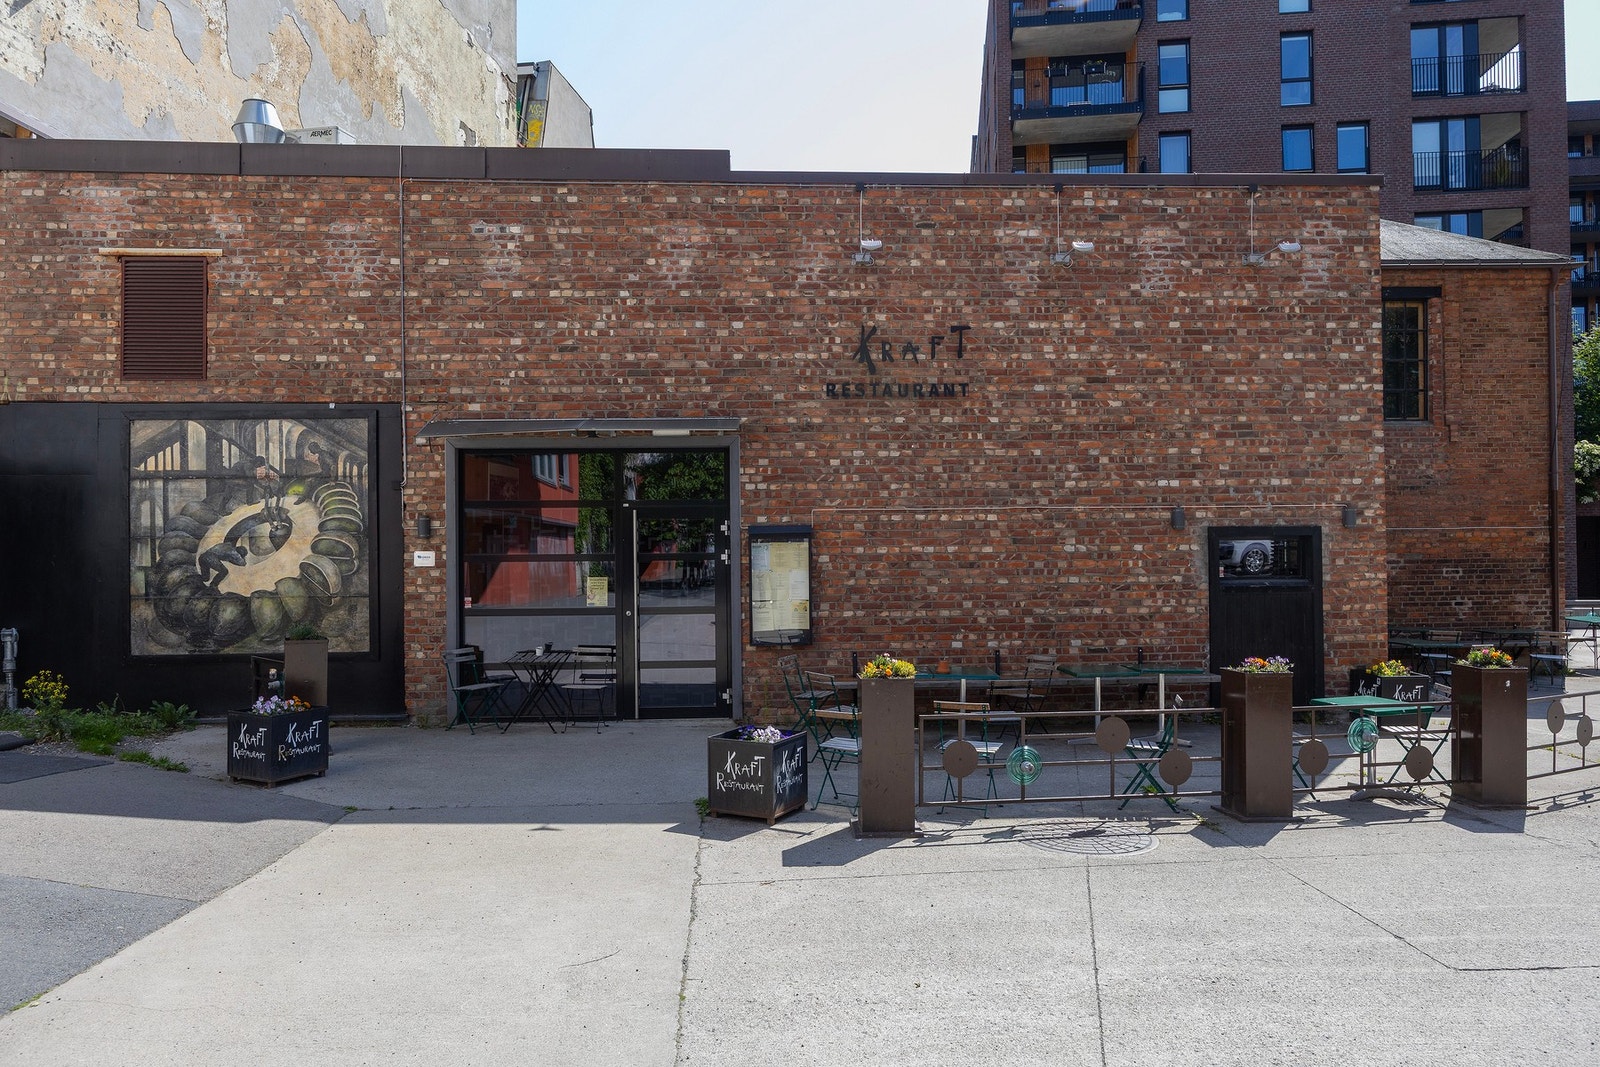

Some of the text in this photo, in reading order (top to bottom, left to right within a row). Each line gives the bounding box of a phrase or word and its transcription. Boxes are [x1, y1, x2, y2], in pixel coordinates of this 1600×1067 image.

[310, 129, 333, 138] AERMEC
[852, 324, 972, 375] KRAFT
[826, 382, 970, 398] RESTAURANT
[1392, 684, 1424, 703] KRAFT
[238, 722, 268, 749] KRAFT
[285, 719, 323, 748] KRAFT
[723, 750, 766, 780] KRAFT
[781, 746, 804, 778] KRAFT
